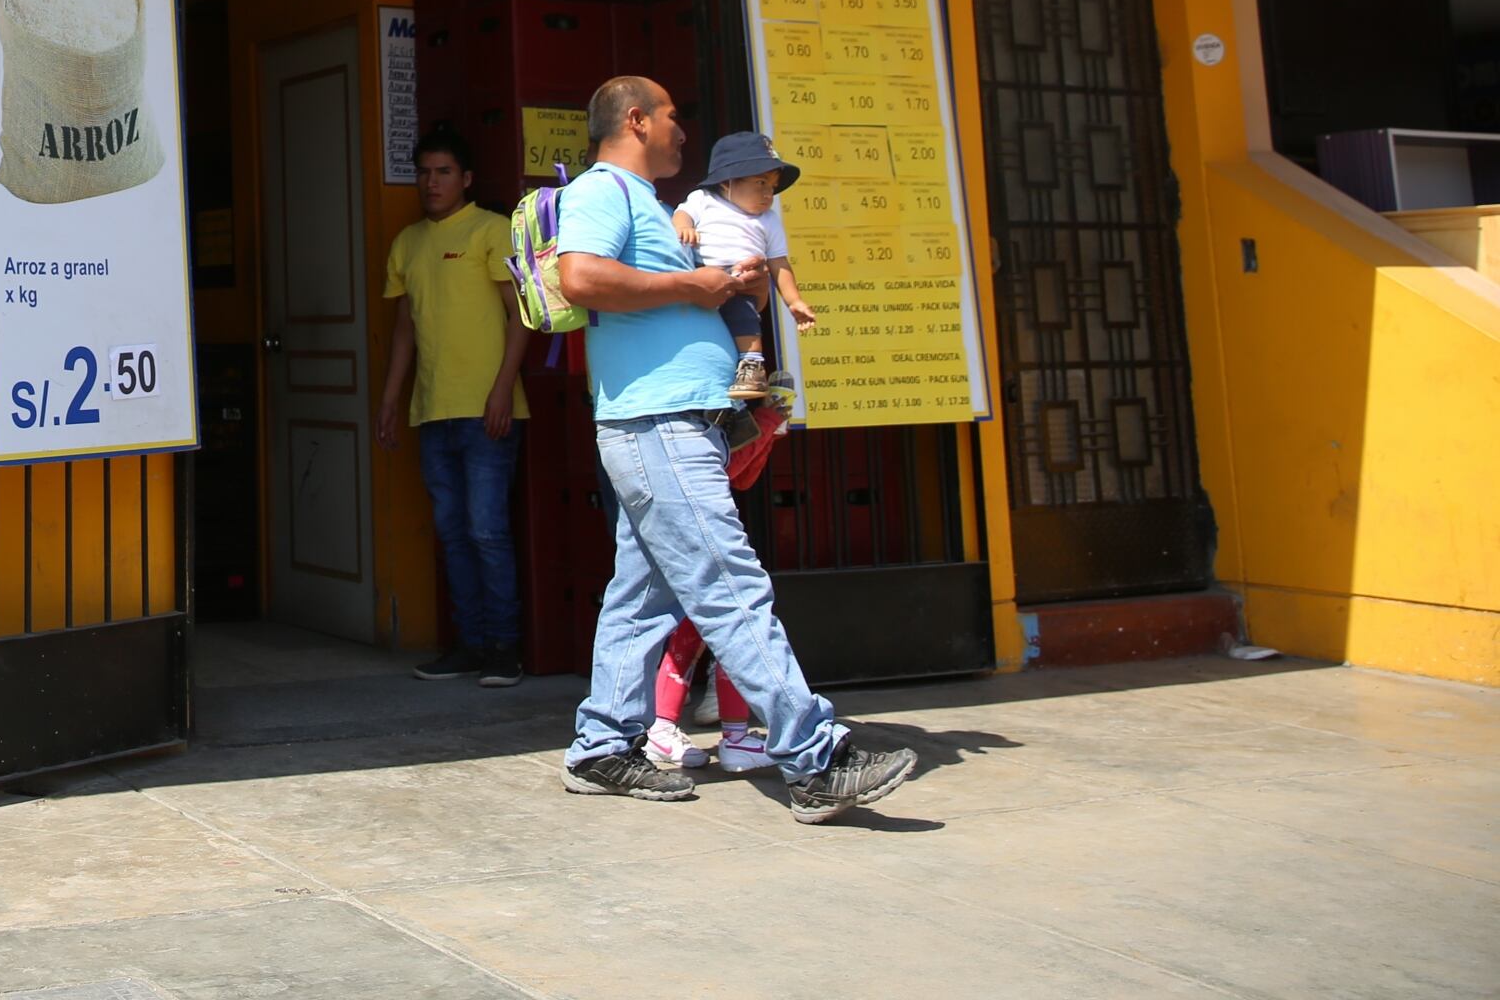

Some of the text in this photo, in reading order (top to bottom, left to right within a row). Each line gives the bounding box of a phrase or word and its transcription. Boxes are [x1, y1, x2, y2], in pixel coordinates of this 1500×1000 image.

[843, 46, 869, 59] 1.70
[900, 48, 924, 61] 1.20
[790, 91, 816, 104] 2.40
[849, 96, 874, 109] 1.00
[906, 98, 930, 111] 1.70
[38, 108, 140, 162] ARROZ
[552, 148, 588, 166] 45.6
[796, 145, 823, 159] 4.00
[855, 148, 880, 161] 1.40
[911, 147, 935, 160] 2.00
[803, 197, 827, 210] 1.00
[861, 196, 888, 209] 4.50
[916, 197, 941, 209] 1.10
[810, 249, 836, 262] 1.00
[866, 247, 893, 260] 3.20
[926, 247, 951, 260] 1.60
[4, 257, 109, 280] Arroz a granel
[797, 282, 827, 292] GLORIA
[884, 281, 912, 290] GLORIA
[5, 285, 37, 308] x kg
[839, 304, 860, 313] PACK
[921, 302, 940, 311] PACK
[810, 356, 840, 366] GLORIA
[855, 355, 876, 364] ROJA
[891, 352, 960, 362] IDEAL CREMOSITA
[846, 378, 866, 387] PACK
[928, 375, 948, 383] PACK
